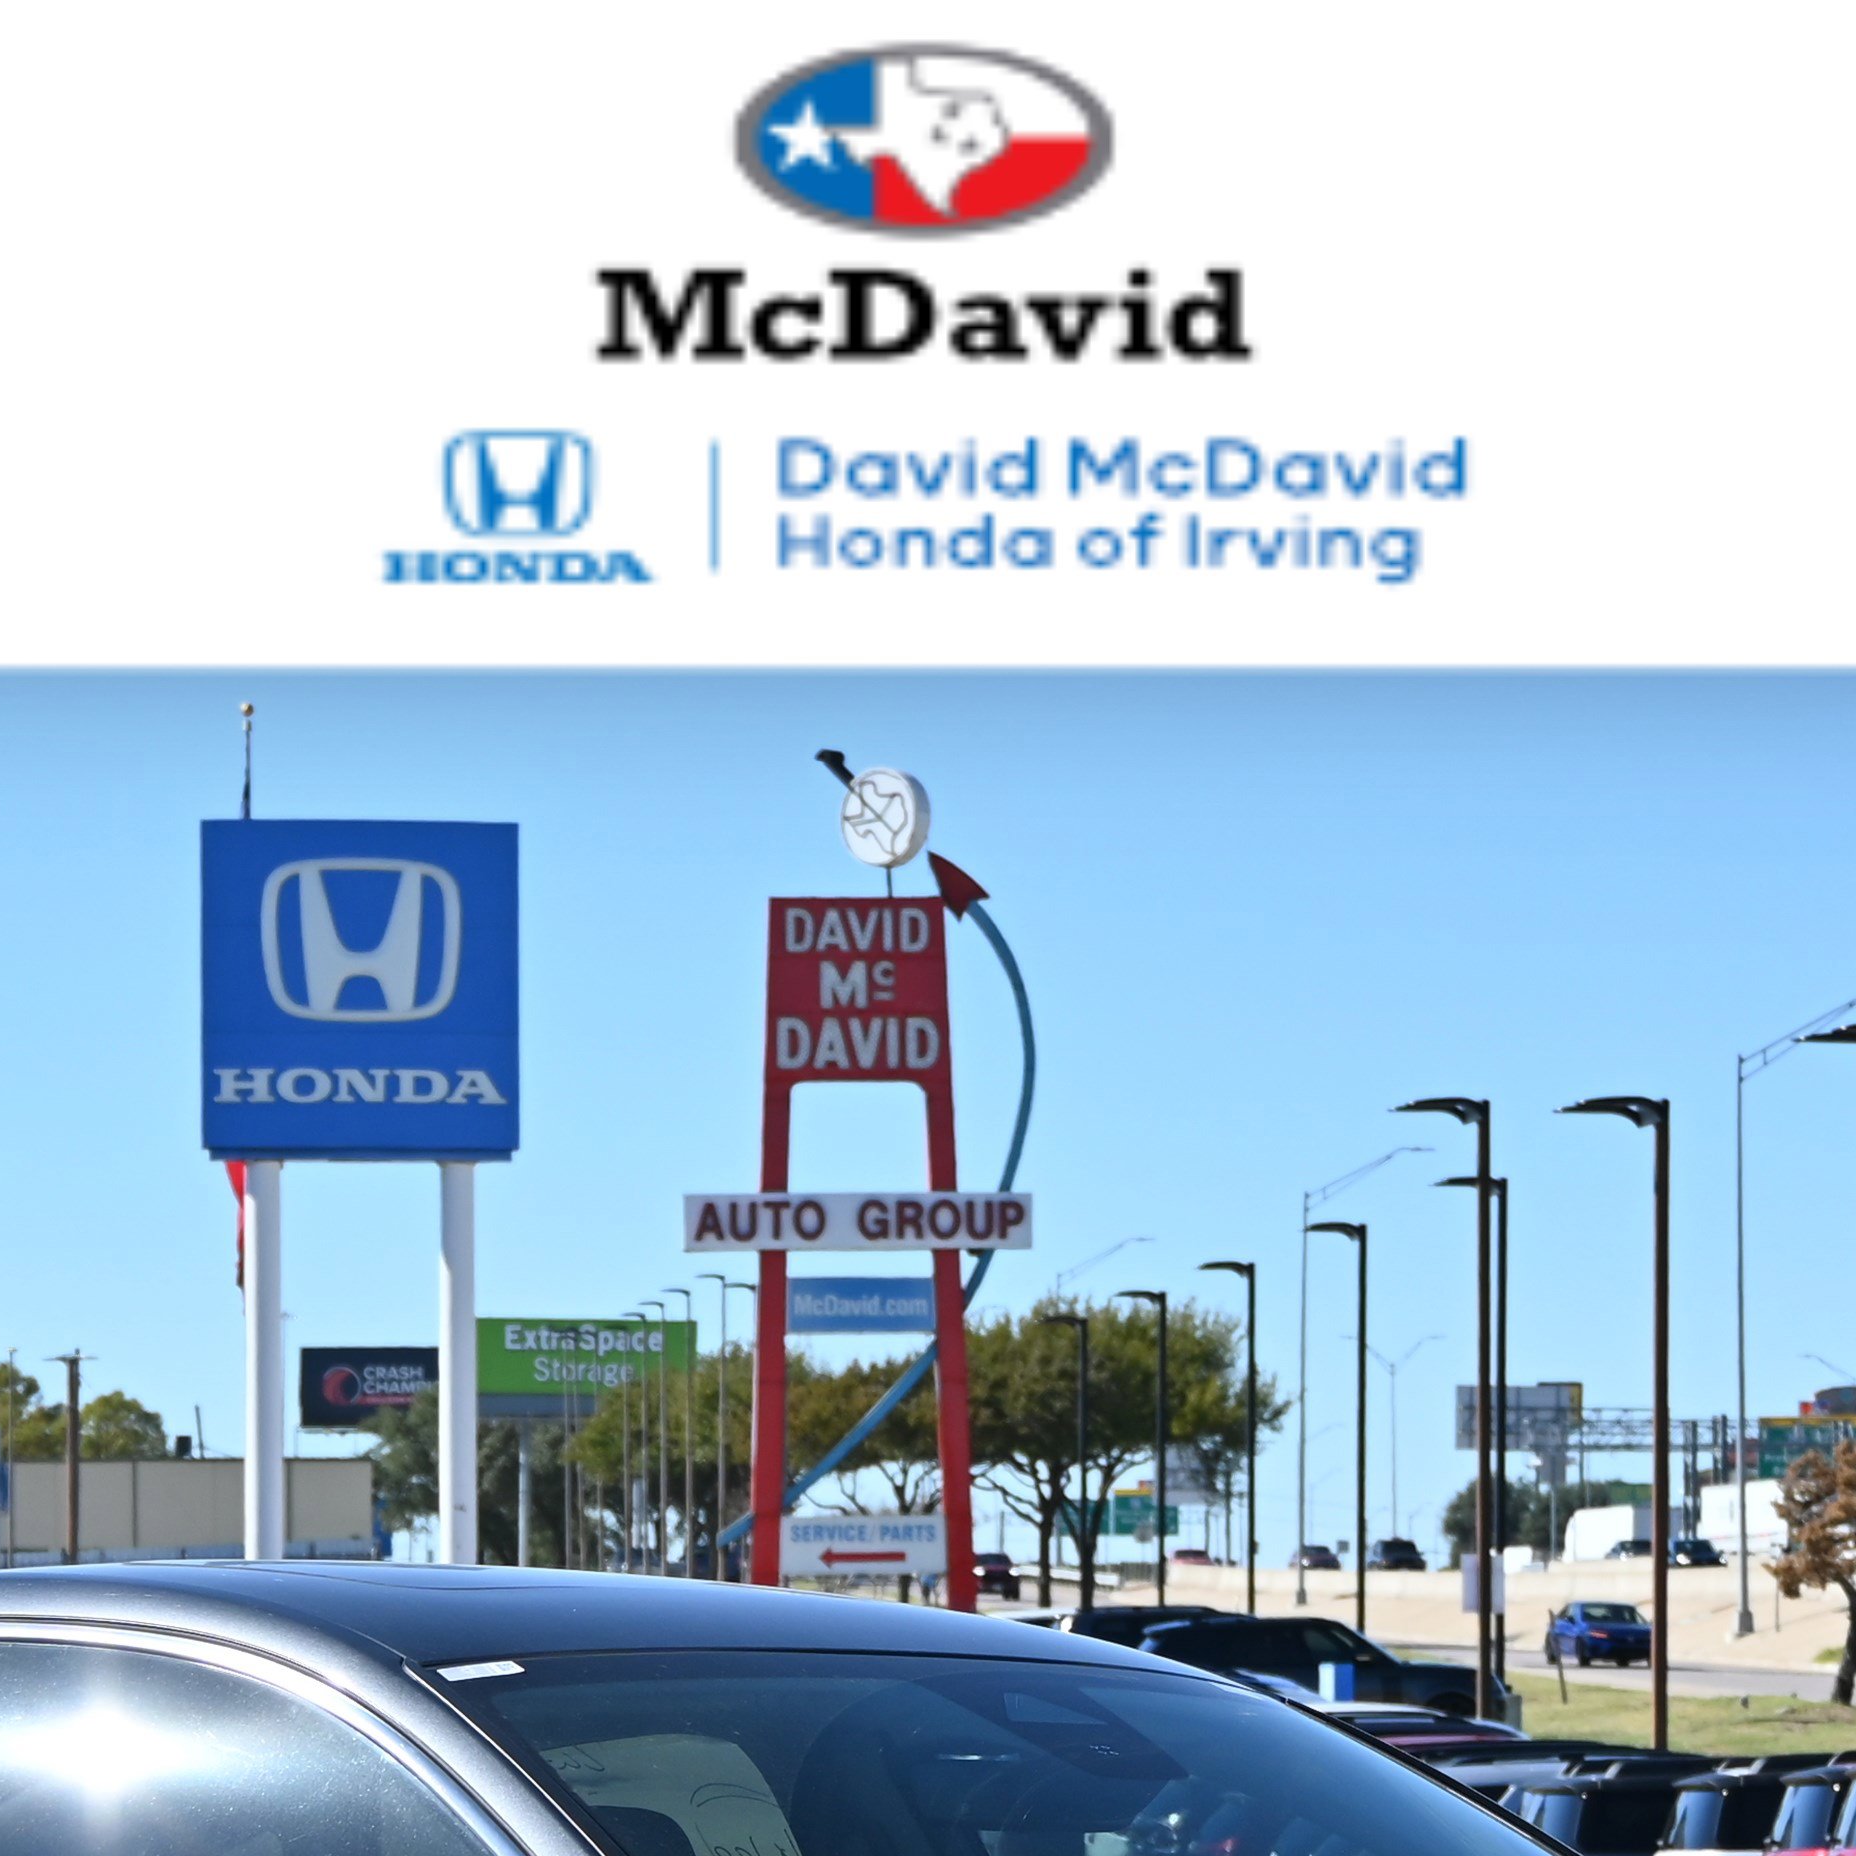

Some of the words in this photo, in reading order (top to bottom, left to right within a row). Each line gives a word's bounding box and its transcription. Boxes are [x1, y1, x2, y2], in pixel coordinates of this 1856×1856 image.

[784, 908, 930, 953] DAVID
[775, 1014, 942, 1072] DAVID
[213, 1067, 508, 1105] HONDA
[693, 1200, 826, 1243] AUTO
[856, 1197, 1026, 1243] GROUP
[793, 1294, 929, 1318] McDavid.com
[363, 1366, 424, 1380] CRASH
[533, 1357, 635, 1388] Storage
[790, 1523, 937, 1544] SERVICE/PARTS
